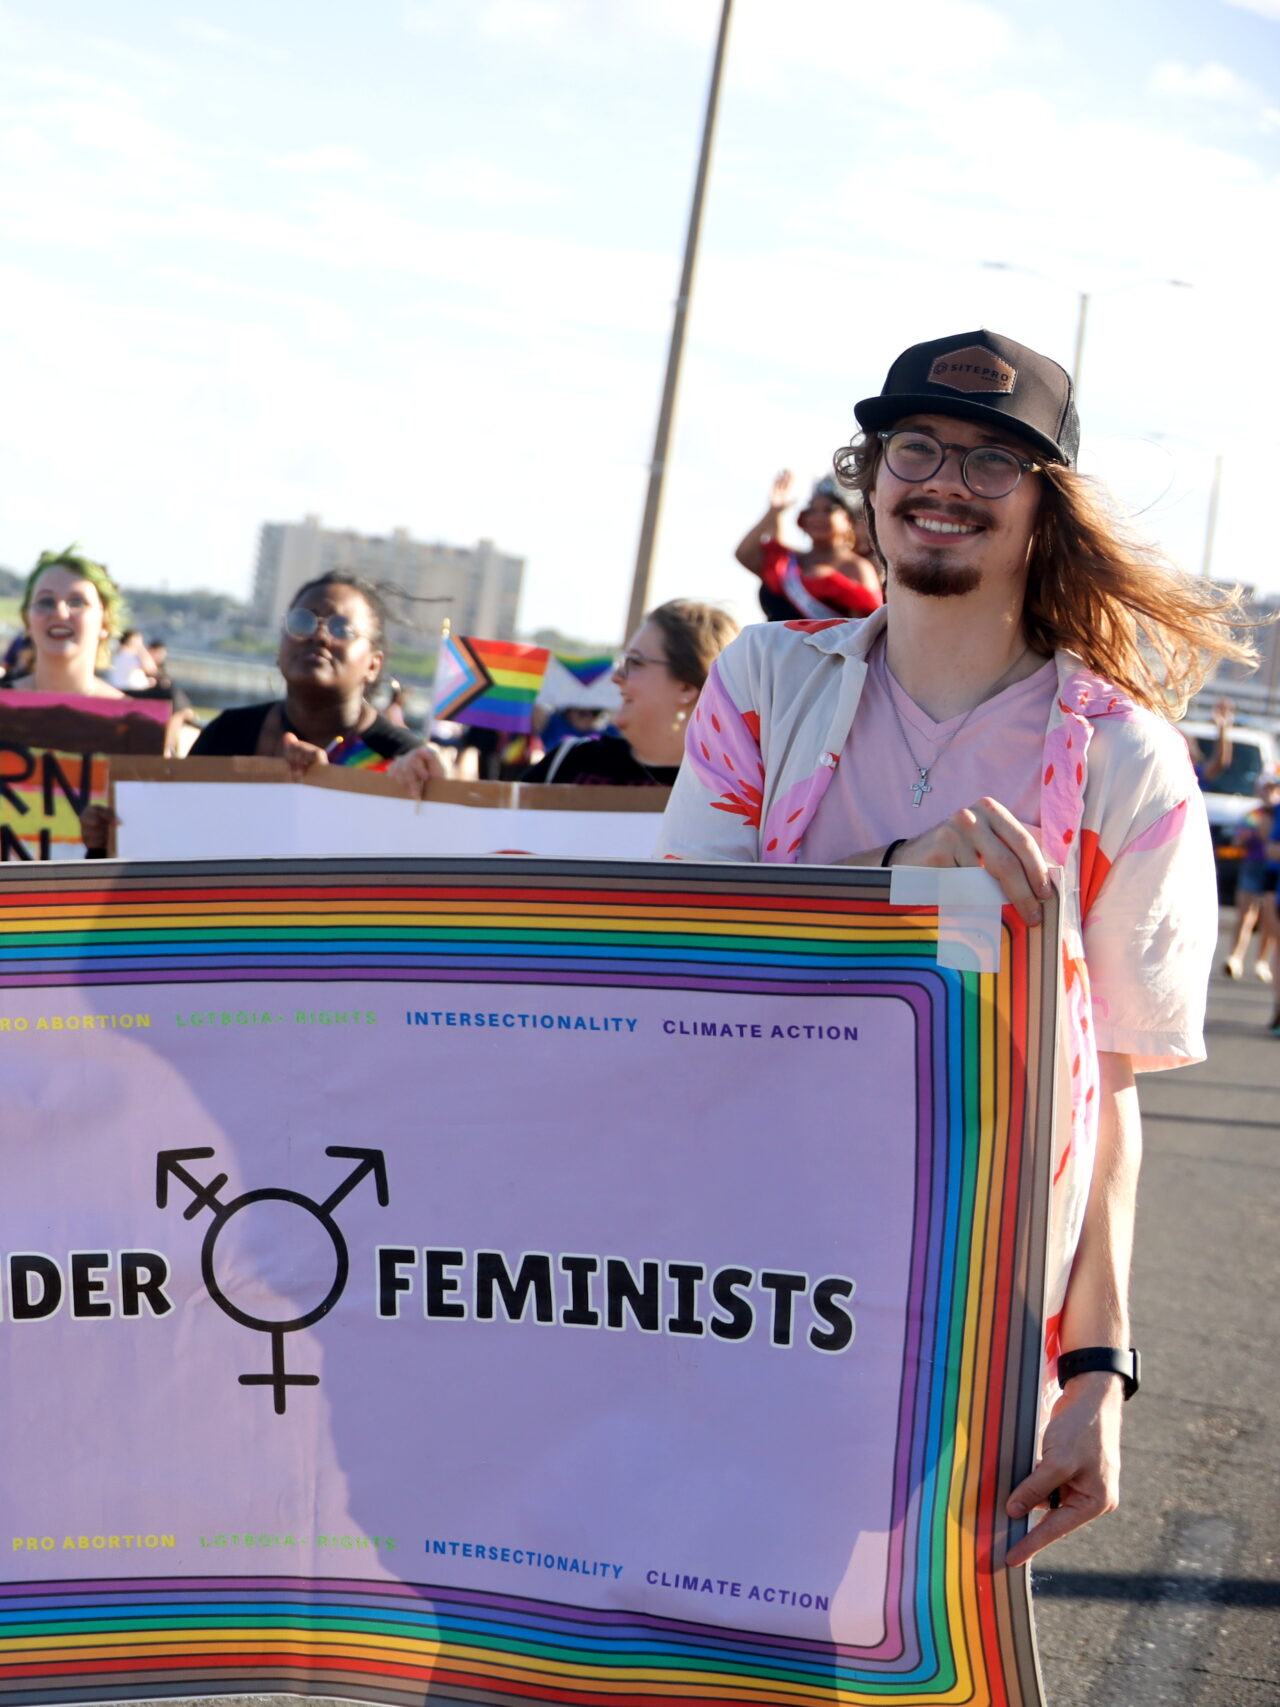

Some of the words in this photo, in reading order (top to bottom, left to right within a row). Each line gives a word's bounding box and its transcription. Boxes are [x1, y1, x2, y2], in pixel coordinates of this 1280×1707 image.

[951, 364, 1009, 381] SITEPRO
[36, 1014, 152, 1031] ABORTION
[296, 1010, 378, 1026] RIGHTS
[406, 1011, 639, 1033] INTERSECTIONALITY
[663, 1019, 763, 1039] CLIMATE
[770, 1024, 859, 1041] ACTION
[376, 1246, 855, 1353] FEMINISTS
[11, 1536, 56, 1551] PRO
[62, 1534, 177, 1550] ABORTION
[316, 1535, 398, 1551] RIGHTS
[424, 1539, 624, 1580] INTERSECTIONALITY
[646, 1569, 742, 1598] CLIMATE
[748, 1585, 830, 1612] ACTION
